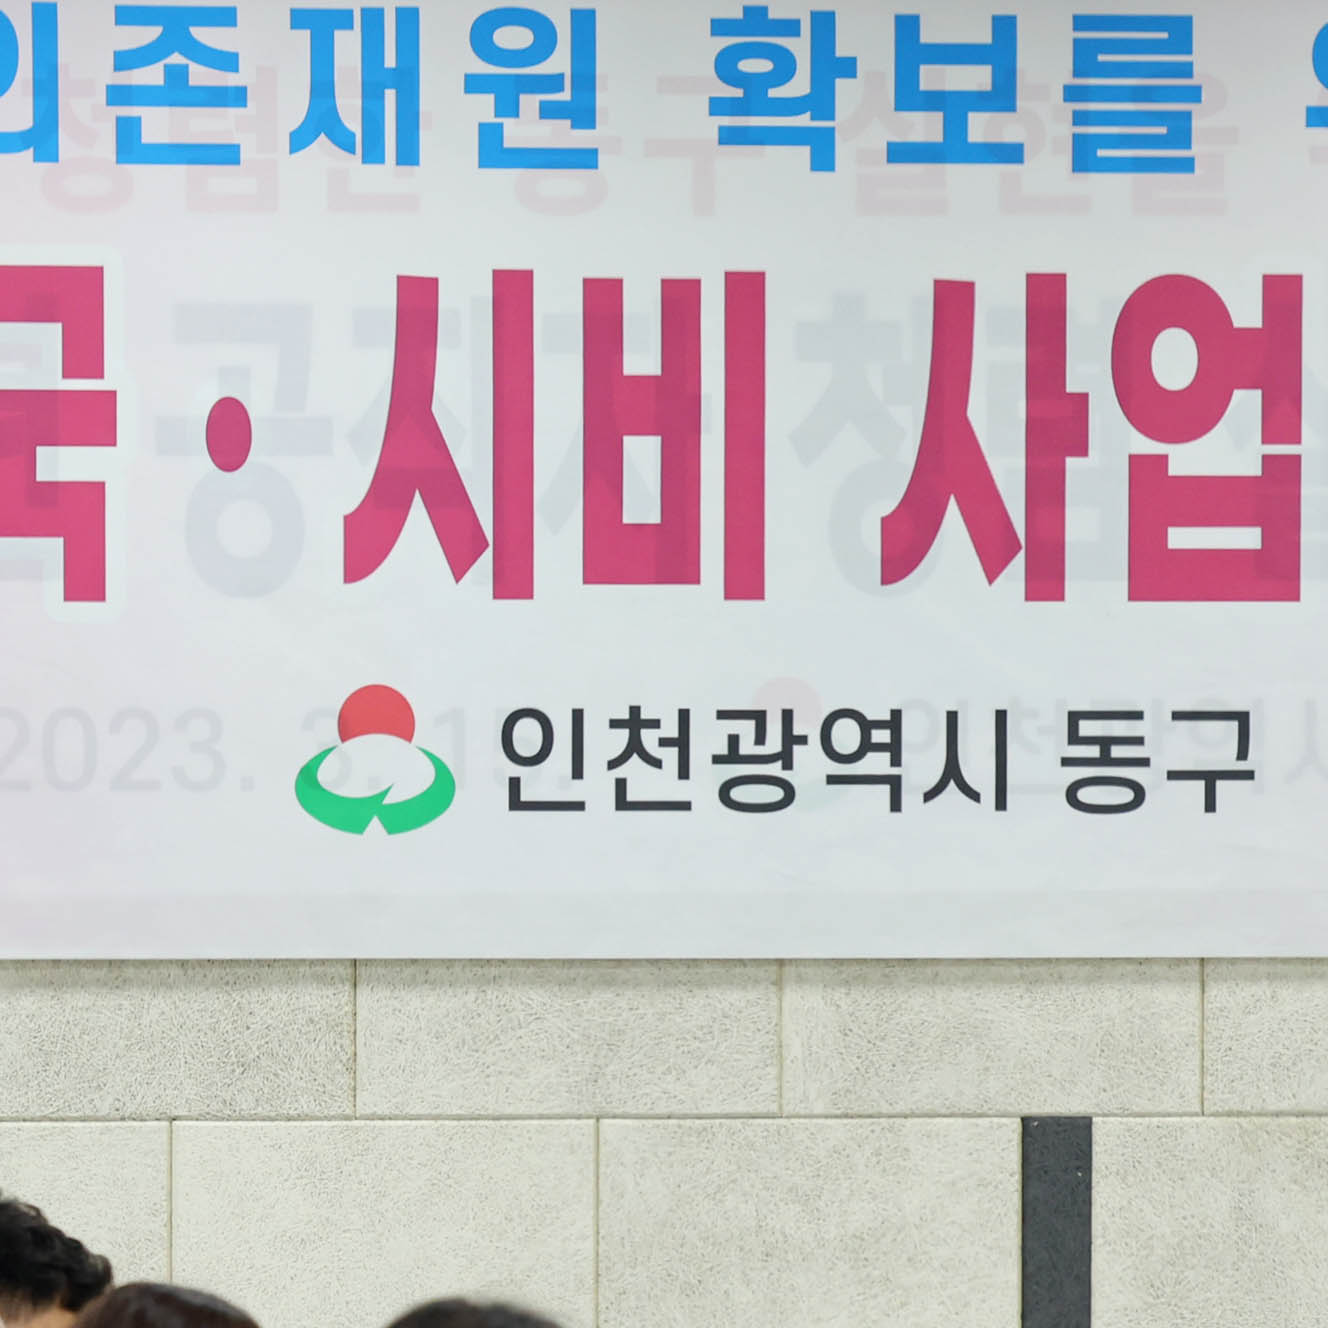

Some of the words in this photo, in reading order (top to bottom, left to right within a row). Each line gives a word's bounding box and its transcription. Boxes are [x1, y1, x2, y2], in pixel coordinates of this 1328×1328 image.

[709, 5, 1202, 173] 확보를
[881, 273, 1303, 602] 사업
[501, 705, 1007, 813] 인천광역시
[1060, 710, 1255, 814] 동구
